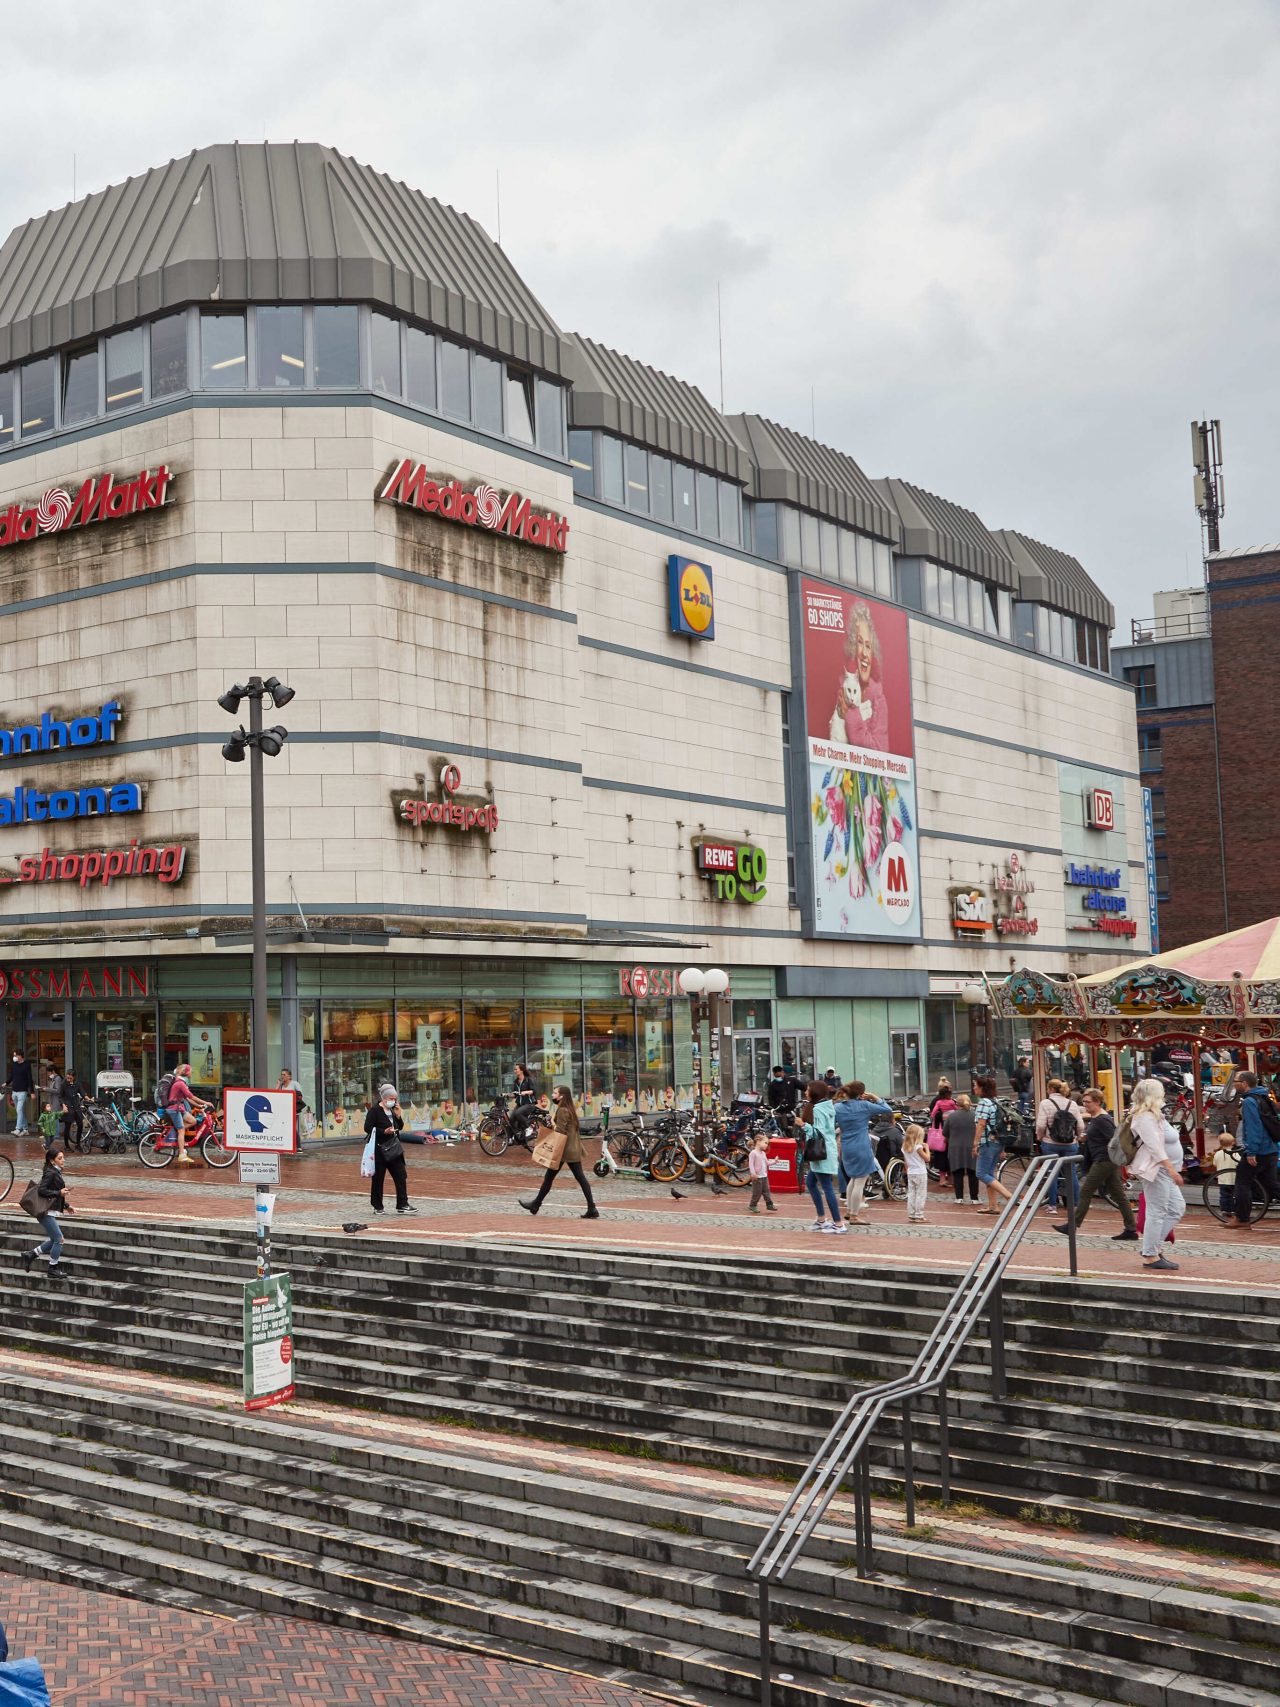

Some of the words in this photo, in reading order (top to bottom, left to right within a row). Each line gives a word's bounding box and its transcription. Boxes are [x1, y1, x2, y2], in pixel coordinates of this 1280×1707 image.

[62, 465, 174, 529] Markt
[381, 459, 477, 525] Media
[496, 493, 569, 553] Markt
[808, 609, 818, 624] 60
[819, 611, 844, 629] SHOPS
[812, 743, 826, 757] Mehr
[827, 746, 849, 763] Charme.
[849, 751, 862, 764] Mehr
[886, 759, 907, 774] Mercado.
[400, 799, 498, 833] sportspaß
[1097, 795, 1111, 822] DB
[19, 840, 186, 887] shopping
[705, 847, 734, 867] REWE
[737, 846, 767, 882] GO
[1144, 790, 1157, 926] PARKHAUS
[715, 873, 737, 900] TO
[1071, 862, 1121, 889] bahnhof
[886, 898, 910, 908] MERCADO
[1087, 889, 1127, 912] altona
[1097, 914, 1137, 939] shopping
[235, 1134, 284, 1142] MASKENPFLICHT
[262, 1322, 268, 1331] EU
